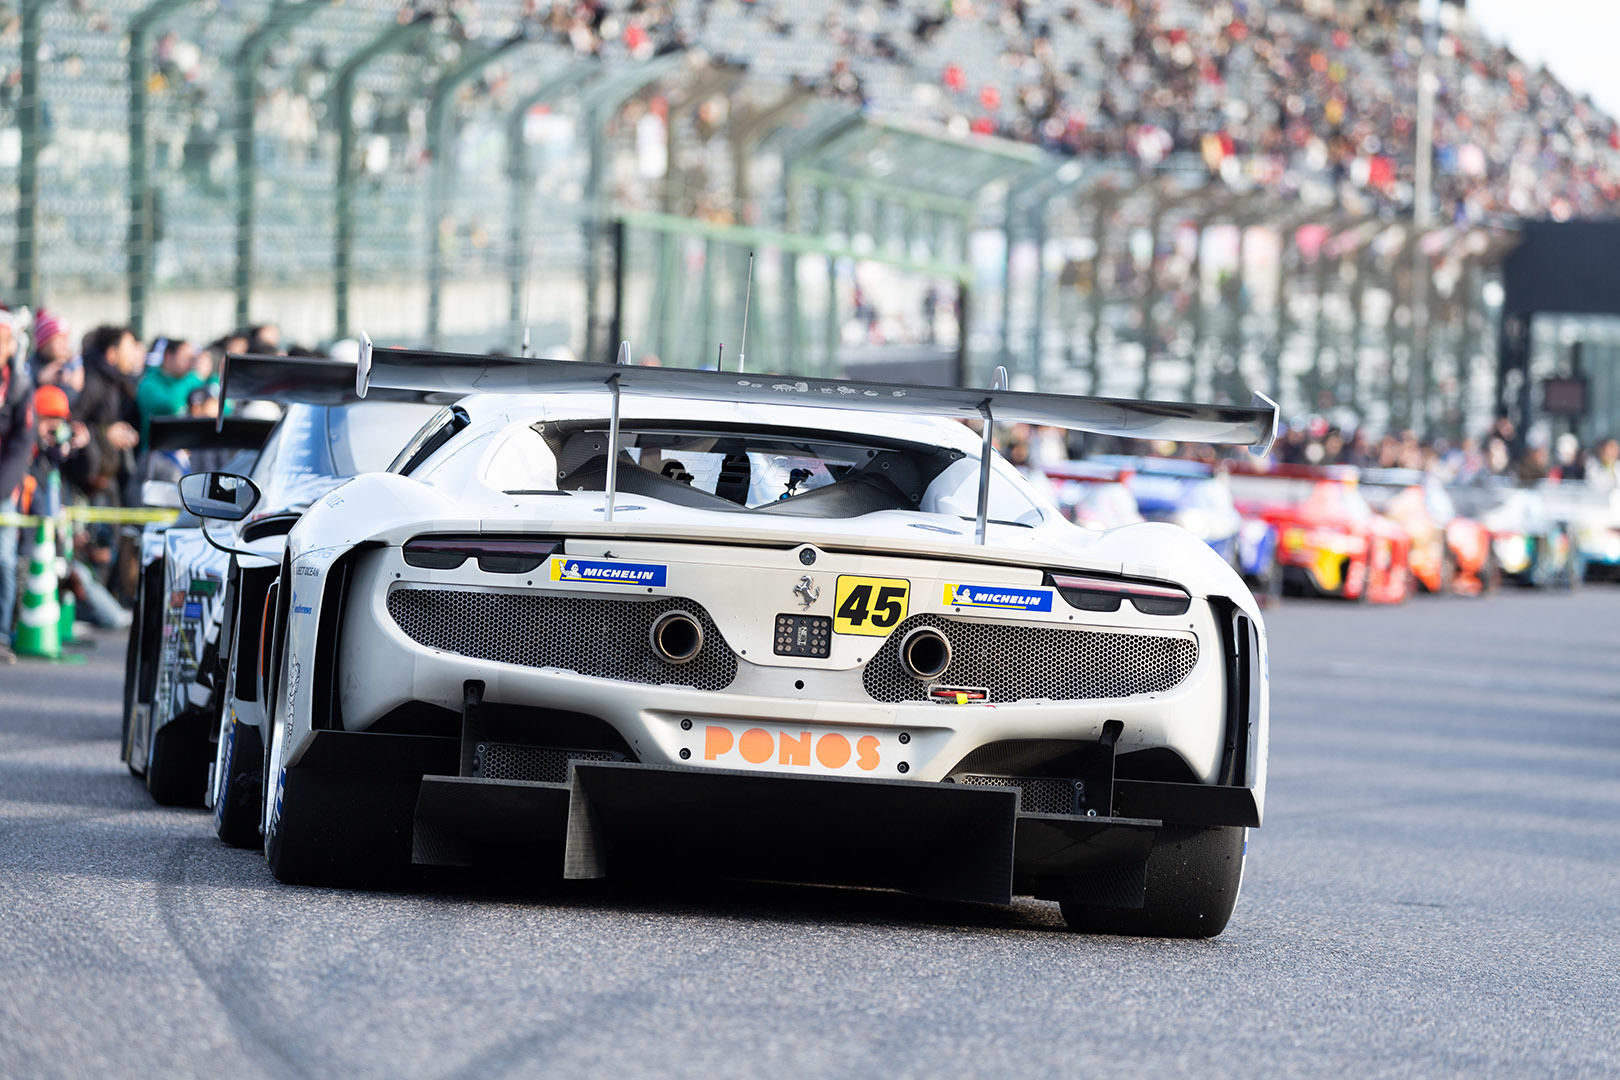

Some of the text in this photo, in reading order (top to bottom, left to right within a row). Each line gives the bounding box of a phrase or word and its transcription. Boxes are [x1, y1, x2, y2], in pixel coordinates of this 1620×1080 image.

[583, 567, 654, 580] MICHELIN
[837, 584, 907, 628] 45
[974, 593, 1041, 606] MICHELIN
[704, 725, 881, 771] PONOS
